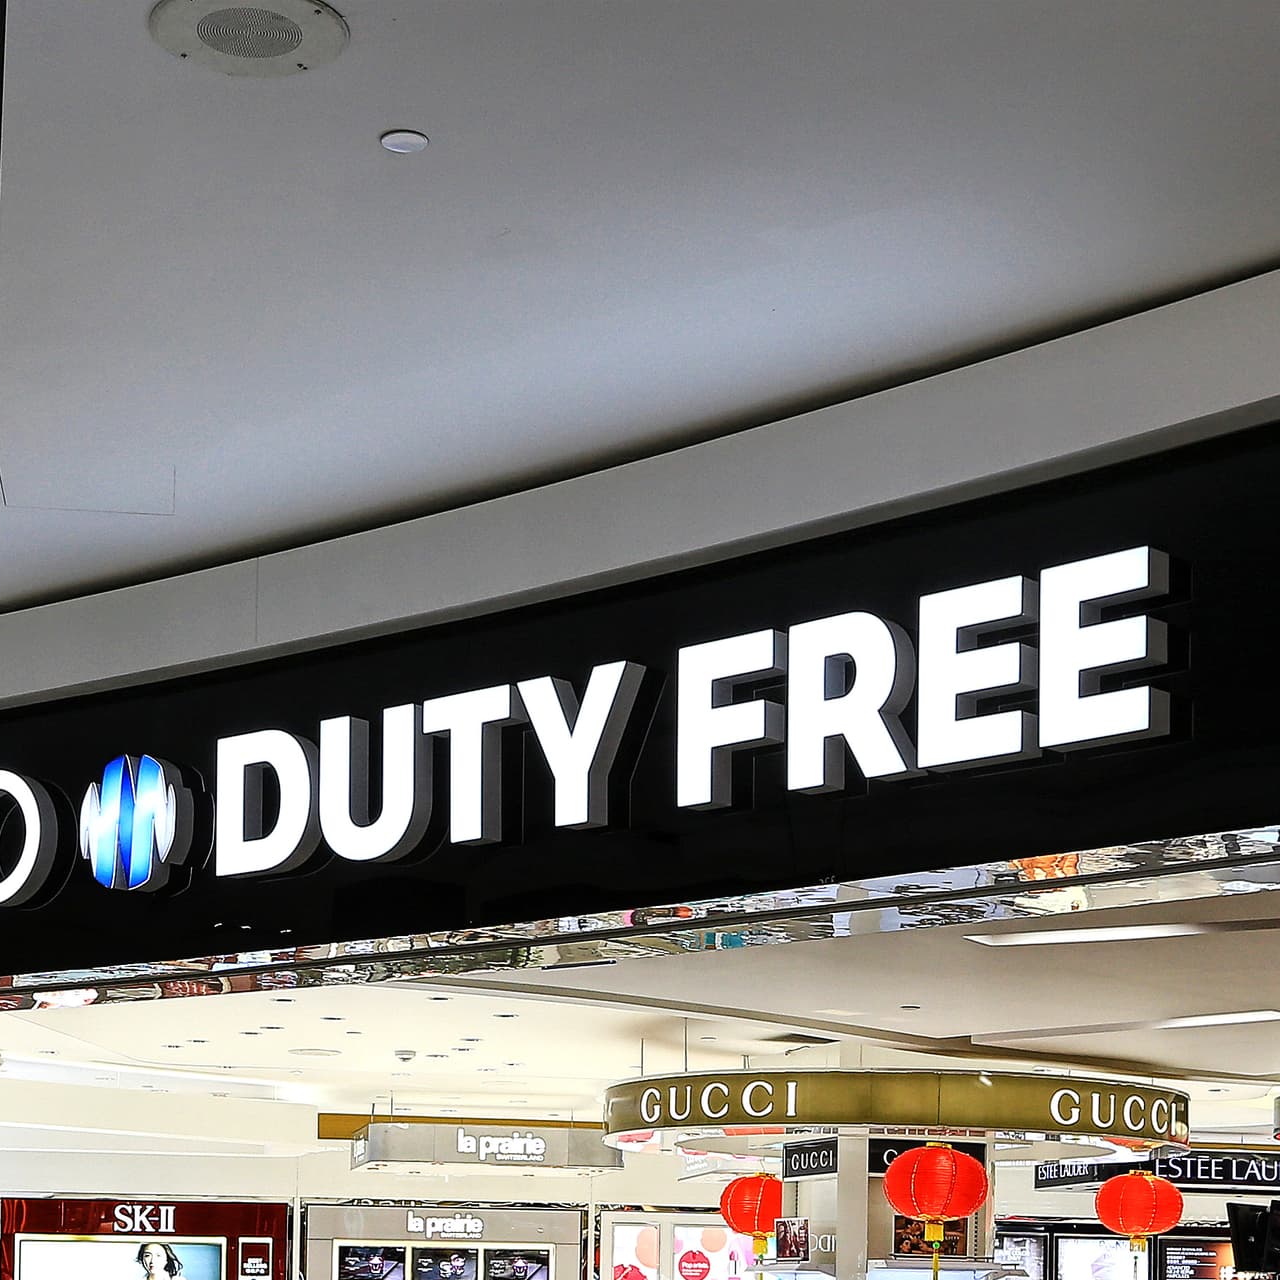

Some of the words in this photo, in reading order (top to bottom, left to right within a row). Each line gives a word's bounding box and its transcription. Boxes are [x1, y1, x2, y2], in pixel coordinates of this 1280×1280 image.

[215, 659, 630, 878] DUTY
[676, 544, 1153, 809] FREE
[639, 1080, 798, 1123] GUCCI
[1049, 1088, 1178, 1137] GUCCI
[456, 1127, 477, 1153] la
[478, 1131, 547, 1161] prairie
[791, 1149, 834, 1171] GUCCI
[1060, 1163, 1089, 1178] LAUDER
[113, 1204, 177, 1233] SK-II
[406, 1209, 424, 1233] la
[425, 1213, 485, 1239] prairie
